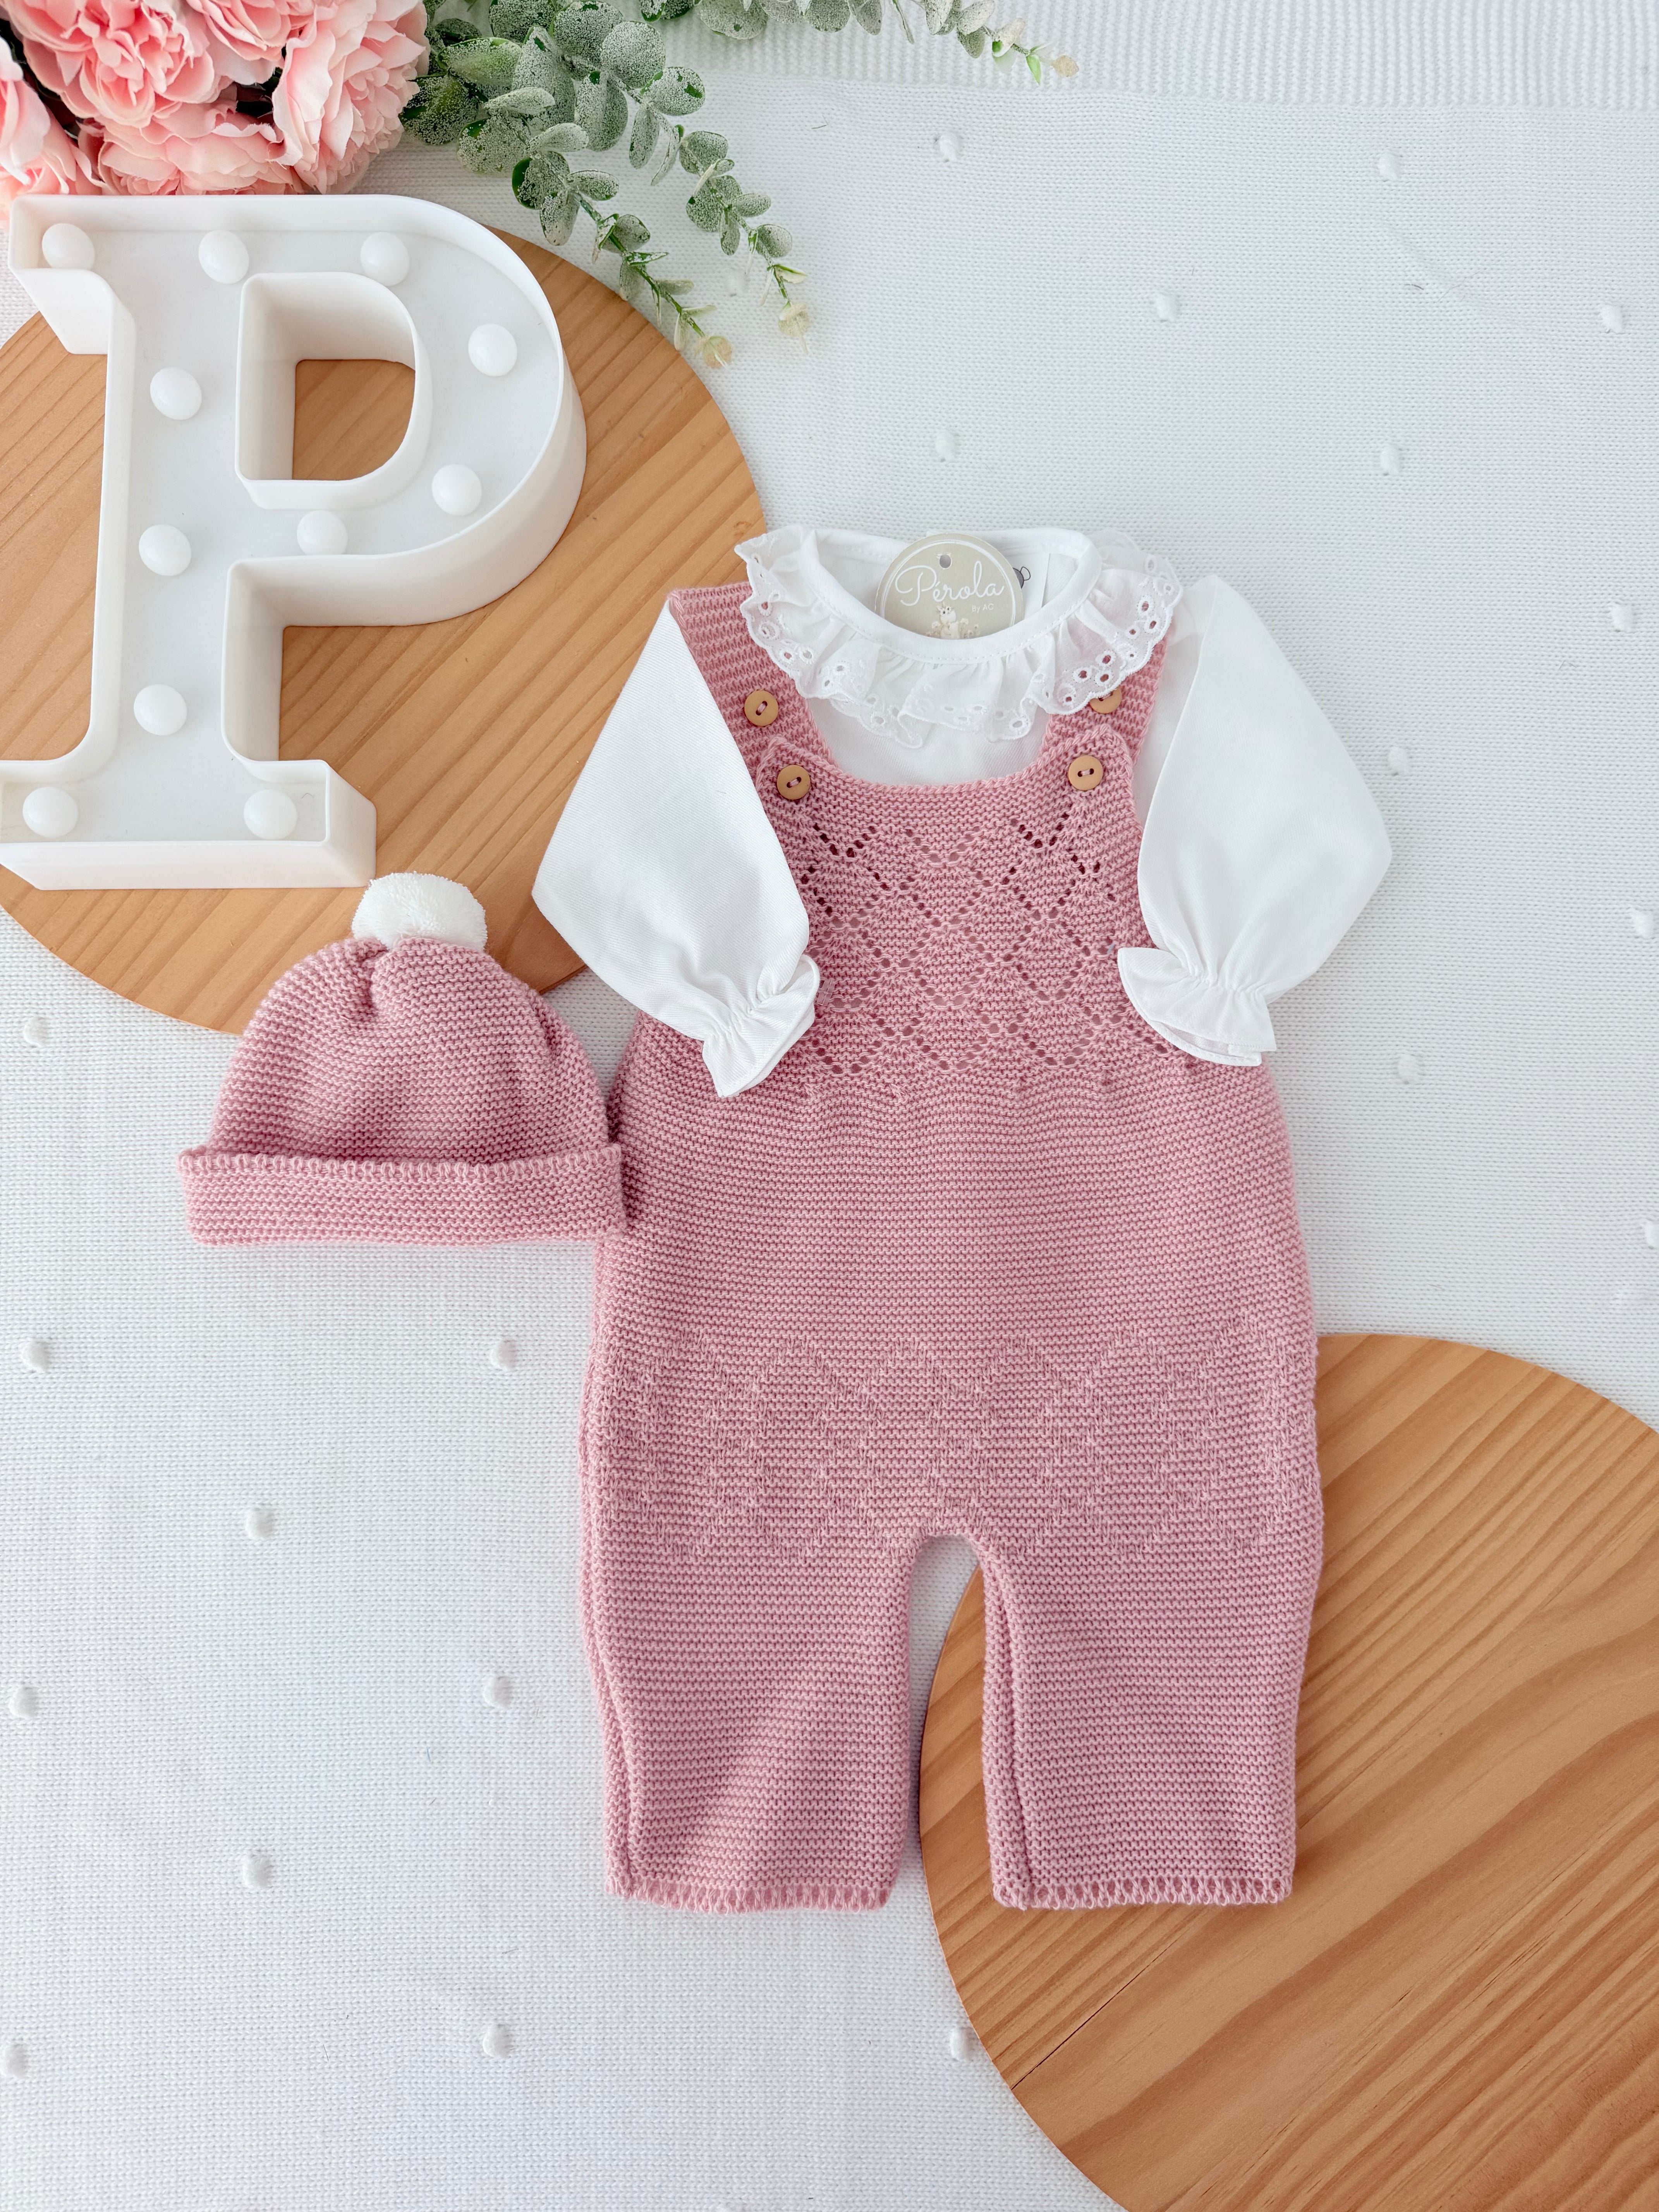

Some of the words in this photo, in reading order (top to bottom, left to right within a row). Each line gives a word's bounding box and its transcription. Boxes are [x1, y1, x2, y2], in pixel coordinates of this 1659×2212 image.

[0, 194, 587, 890] P
[895, 561, 1005, 606] Pérola
[972, 605, 981, 614] By
